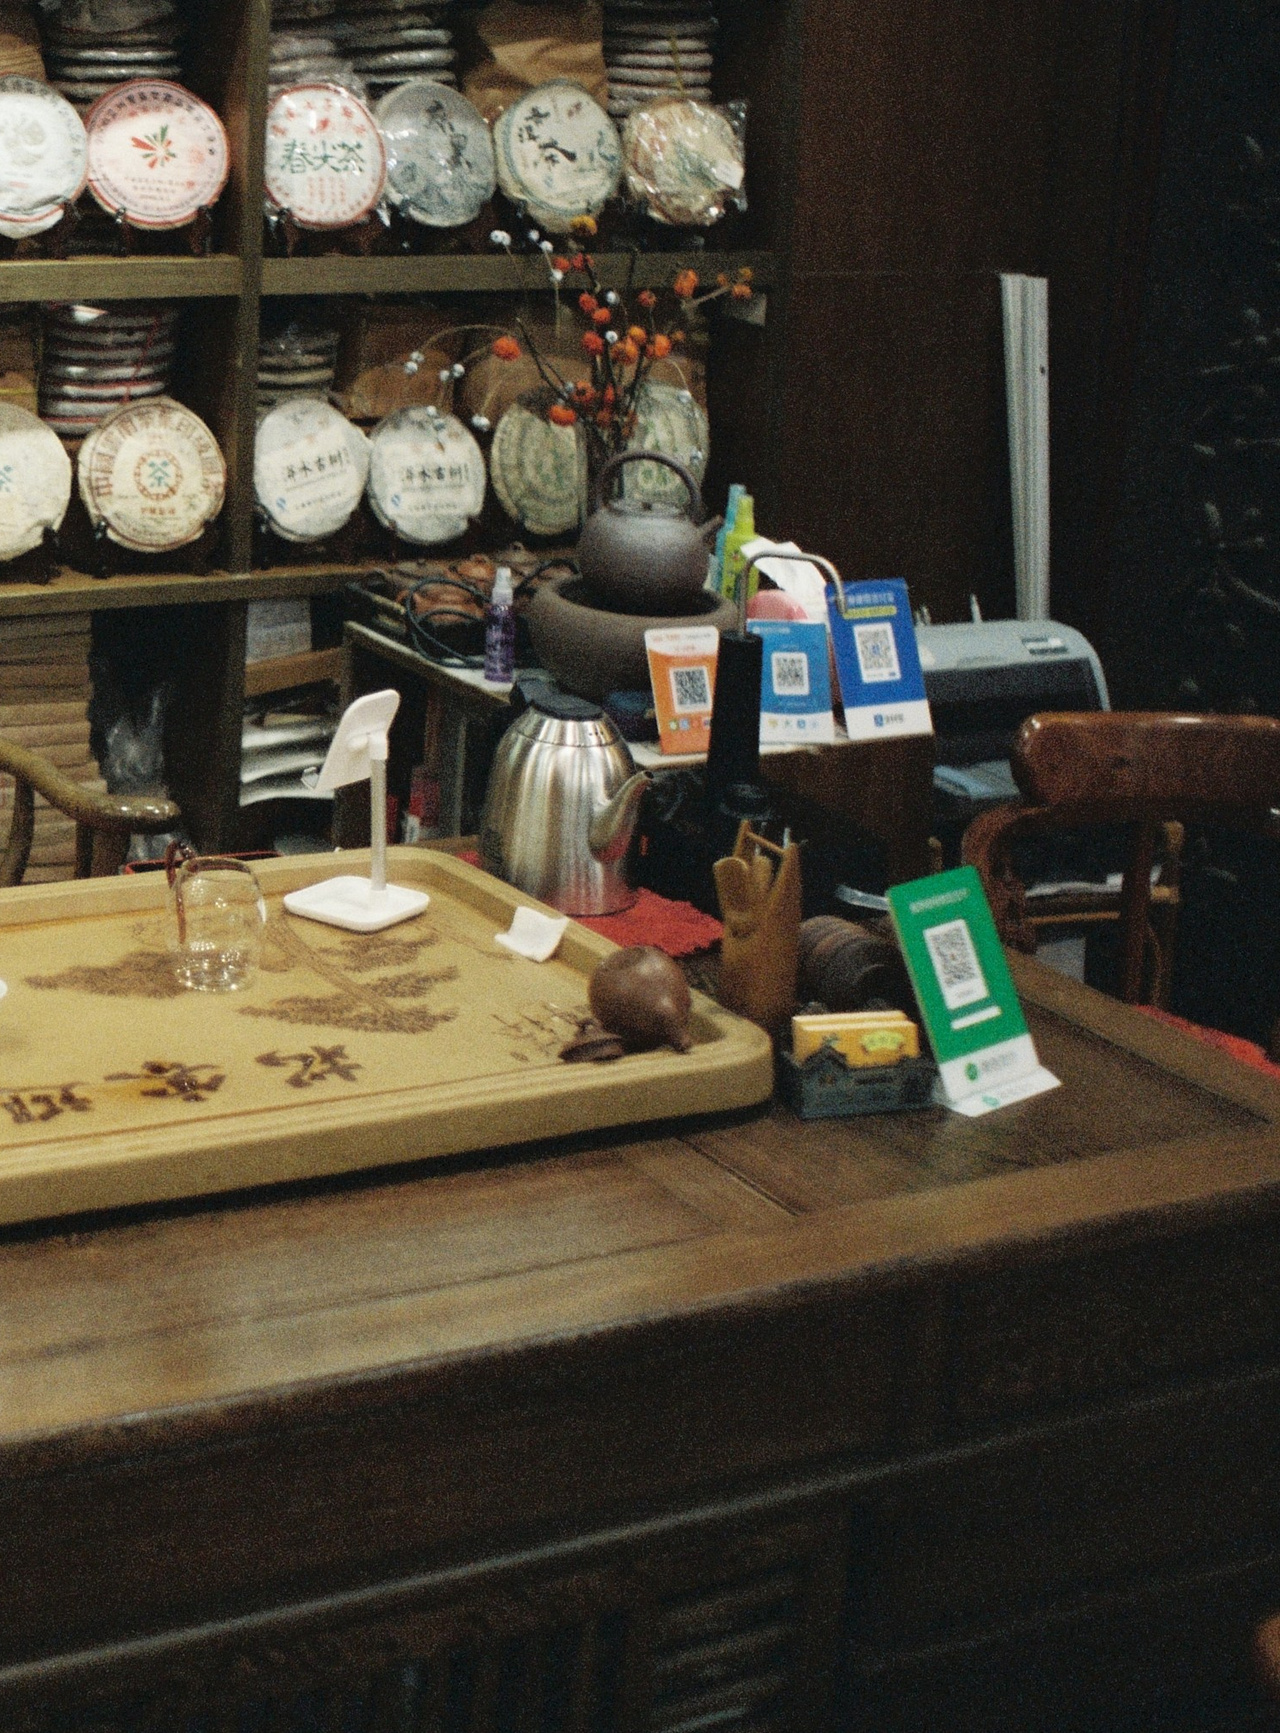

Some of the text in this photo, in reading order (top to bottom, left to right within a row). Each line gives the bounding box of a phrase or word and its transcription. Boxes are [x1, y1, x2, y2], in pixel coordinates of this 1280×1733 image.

[281, 139, 365, 175] 春尖茶
[149, 459, 171, 488] 茶
